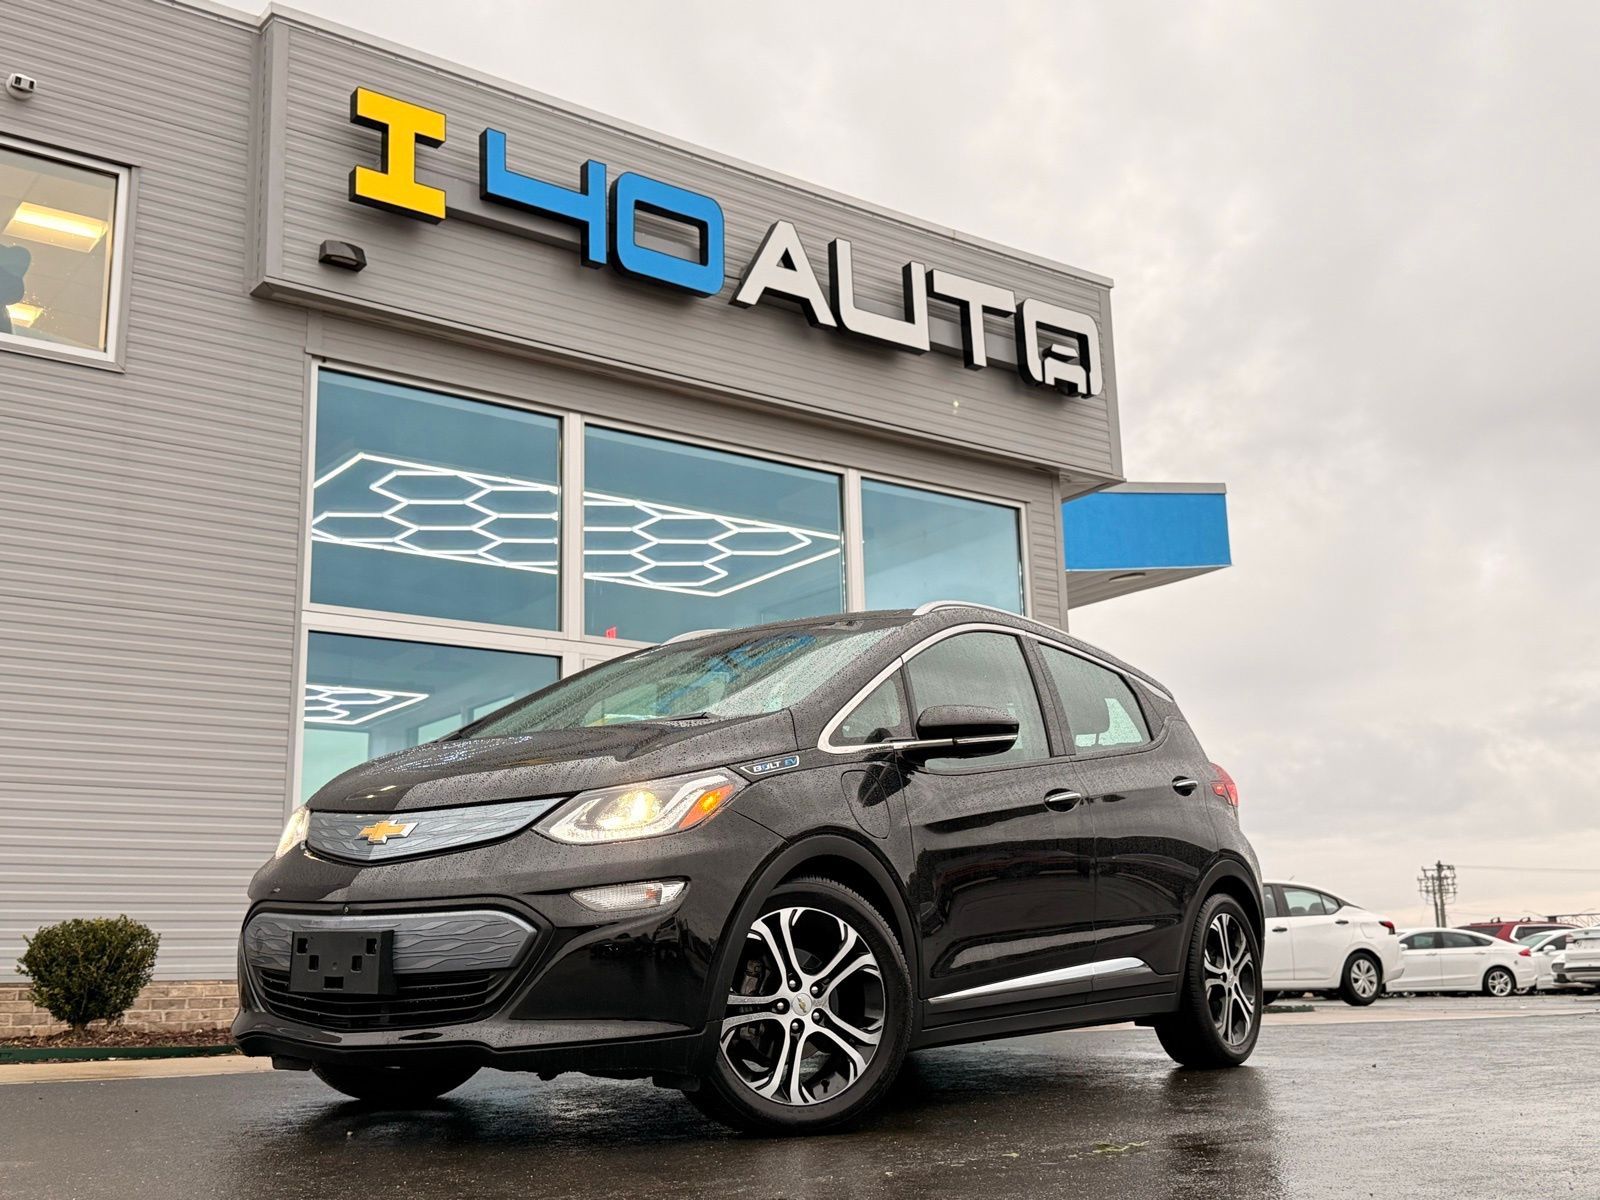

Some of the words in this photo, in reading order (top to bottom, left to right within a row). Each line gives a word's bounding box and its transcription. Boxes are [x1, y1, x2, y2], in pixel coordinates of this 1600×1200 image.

[350, 87, 446, 222] I
[480, 127, 725, 296] 40
[753, 761, 781, 773] BOLT
[784, 758, 797, 766] EV
